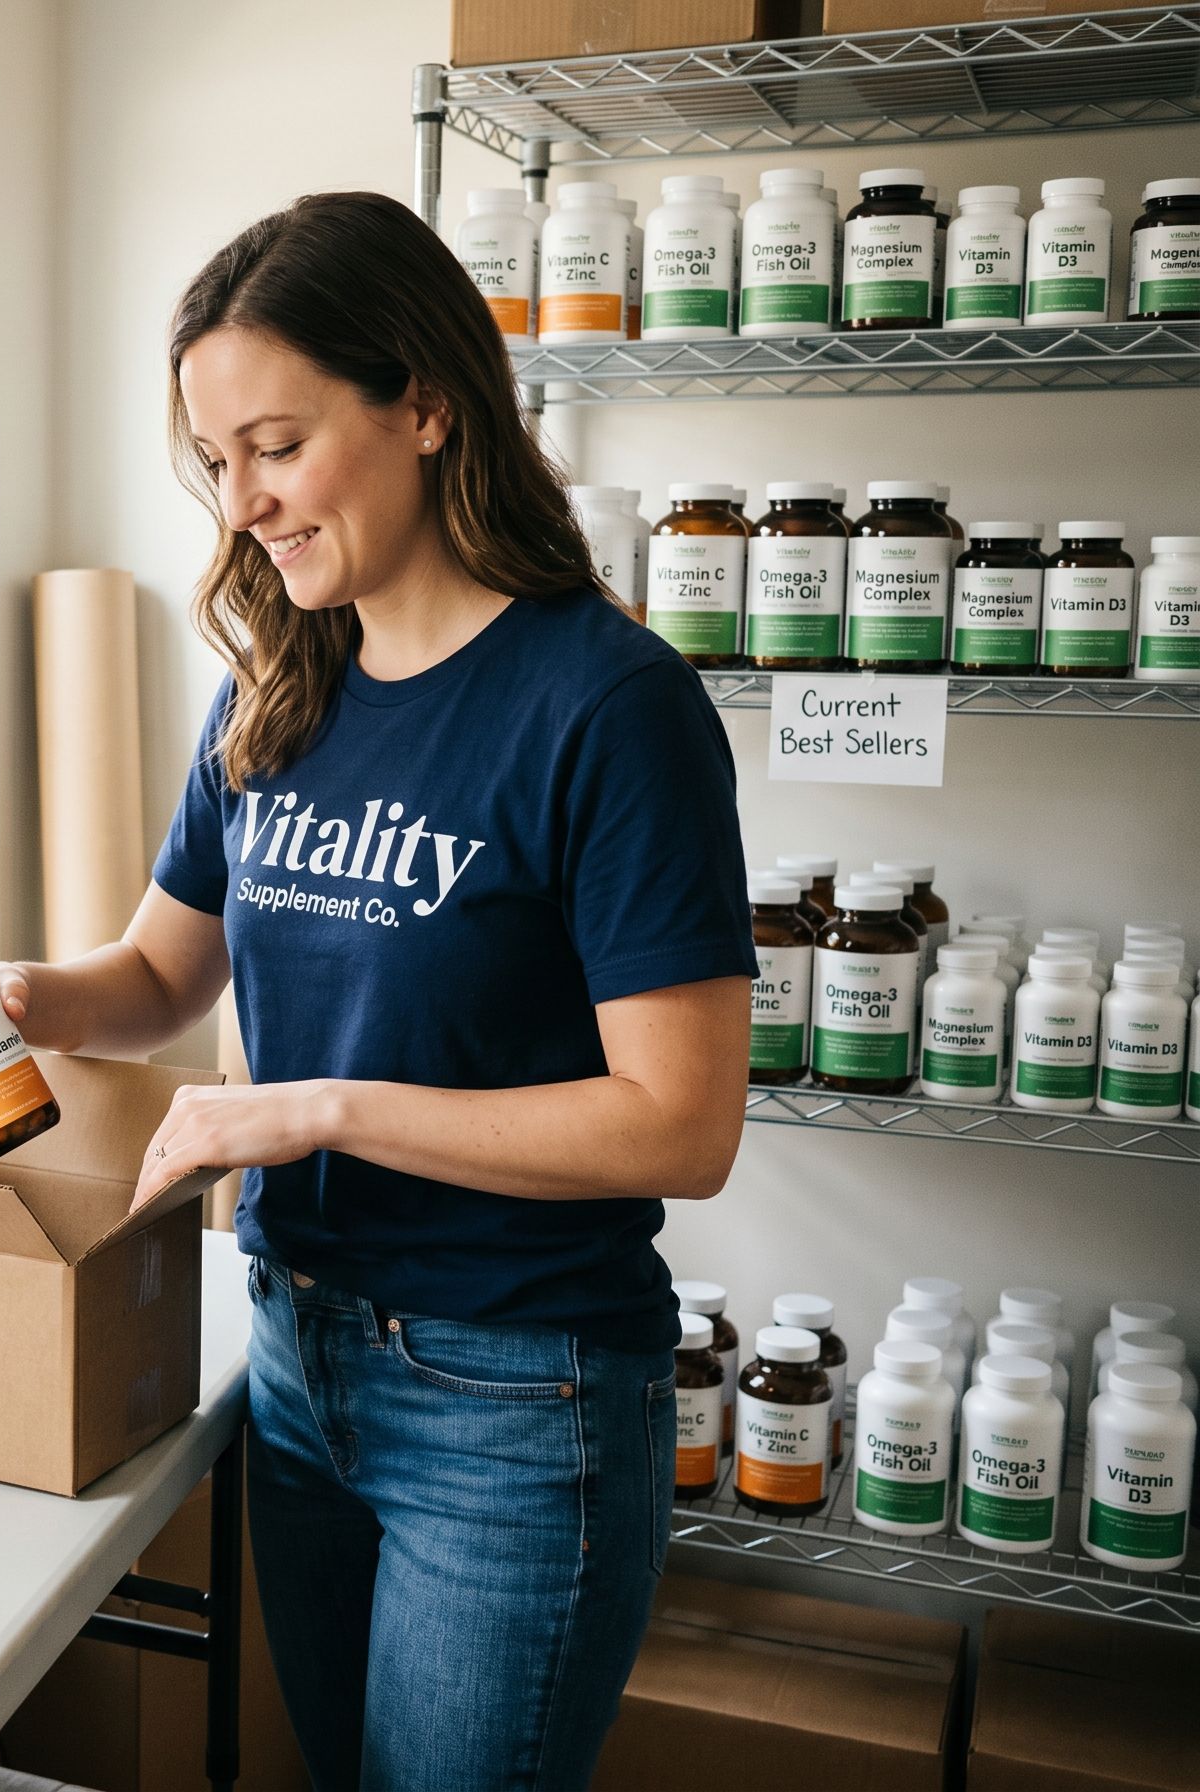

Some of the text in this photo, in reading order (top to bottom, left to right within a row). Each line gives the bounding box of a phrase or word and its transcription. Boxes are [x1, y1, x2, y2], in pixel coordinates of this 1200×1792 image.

[654, 247, 716, 263] Omega-3
[752, 241, 816, 258] Omega-3
[851, 241, 922, 257] Magnesium
[959, 247, 1011, 261] Vitamin
[1042, 240, 1095, 254] Vitamin
[507, 257, 517, 271] C
[547, 252, 610, 268] Vitamin C
[756, 257, 810, 272] Fish Oil
[857, 256, 914, 270] Complex
[1058, 255, 1078, 268] D3
[566, 269, 597, 281] Zinc
[657, 263, 710, 276] Fish Oil
[975, 263, 994, 275] D3
[475, 273, 504, 286] Zinc
[657, 566, 725, 581] Vitamin C
[759, 569, 827, 586] Omega-3
[855, 569, 940, 586] Magnesium
[678, 584, 712, 597] Zinc
[764, 586, 821, 599] Fish Oil
[864, 587, 931, 604] Complex
[961, 591, 1033, 606] Magnesium
[1050, 597, 1127, 612] Vitamin D3
[968, 606, 1024, 620] Complex
[1170, 615, 1190, 626] D3
[801, 689, 901, 718] Current
[780, 727, 928, 757] Best Sellers
[240, 791, 486, 917] Vitality
[237, 877, 400, 928] Supplement Co.
[780, 980, 792, 994] C
[826, 983, 898, 1004] Omega-3
[831, 1001, 890, 1019] Fish Oil
[928, 1017, 994, 1036] Magnesium
[933, 1031, 986, 1048] Complex
[1024, 1032, 1093, 1048] Vitamin D3
[1107, 1038, 1178, 1056] Vitamin D3
[695, 1412, 705, 1425] C
[746, 1420, 809, 1441] Vitamin C
[767, 1440, 797, 1455] Zinc
[867, 1433, 938, 1458] Omega-3
[872, 1452, 931, 1472] Fish Oil
[972, 1449, 1046, 1475] Omega-3
[976, 1466, 1039, 1490] Fish Oil
[1107, 1464, 1174, 1488] Vitamin
[1128, 1488, 1152, 1504] D3
